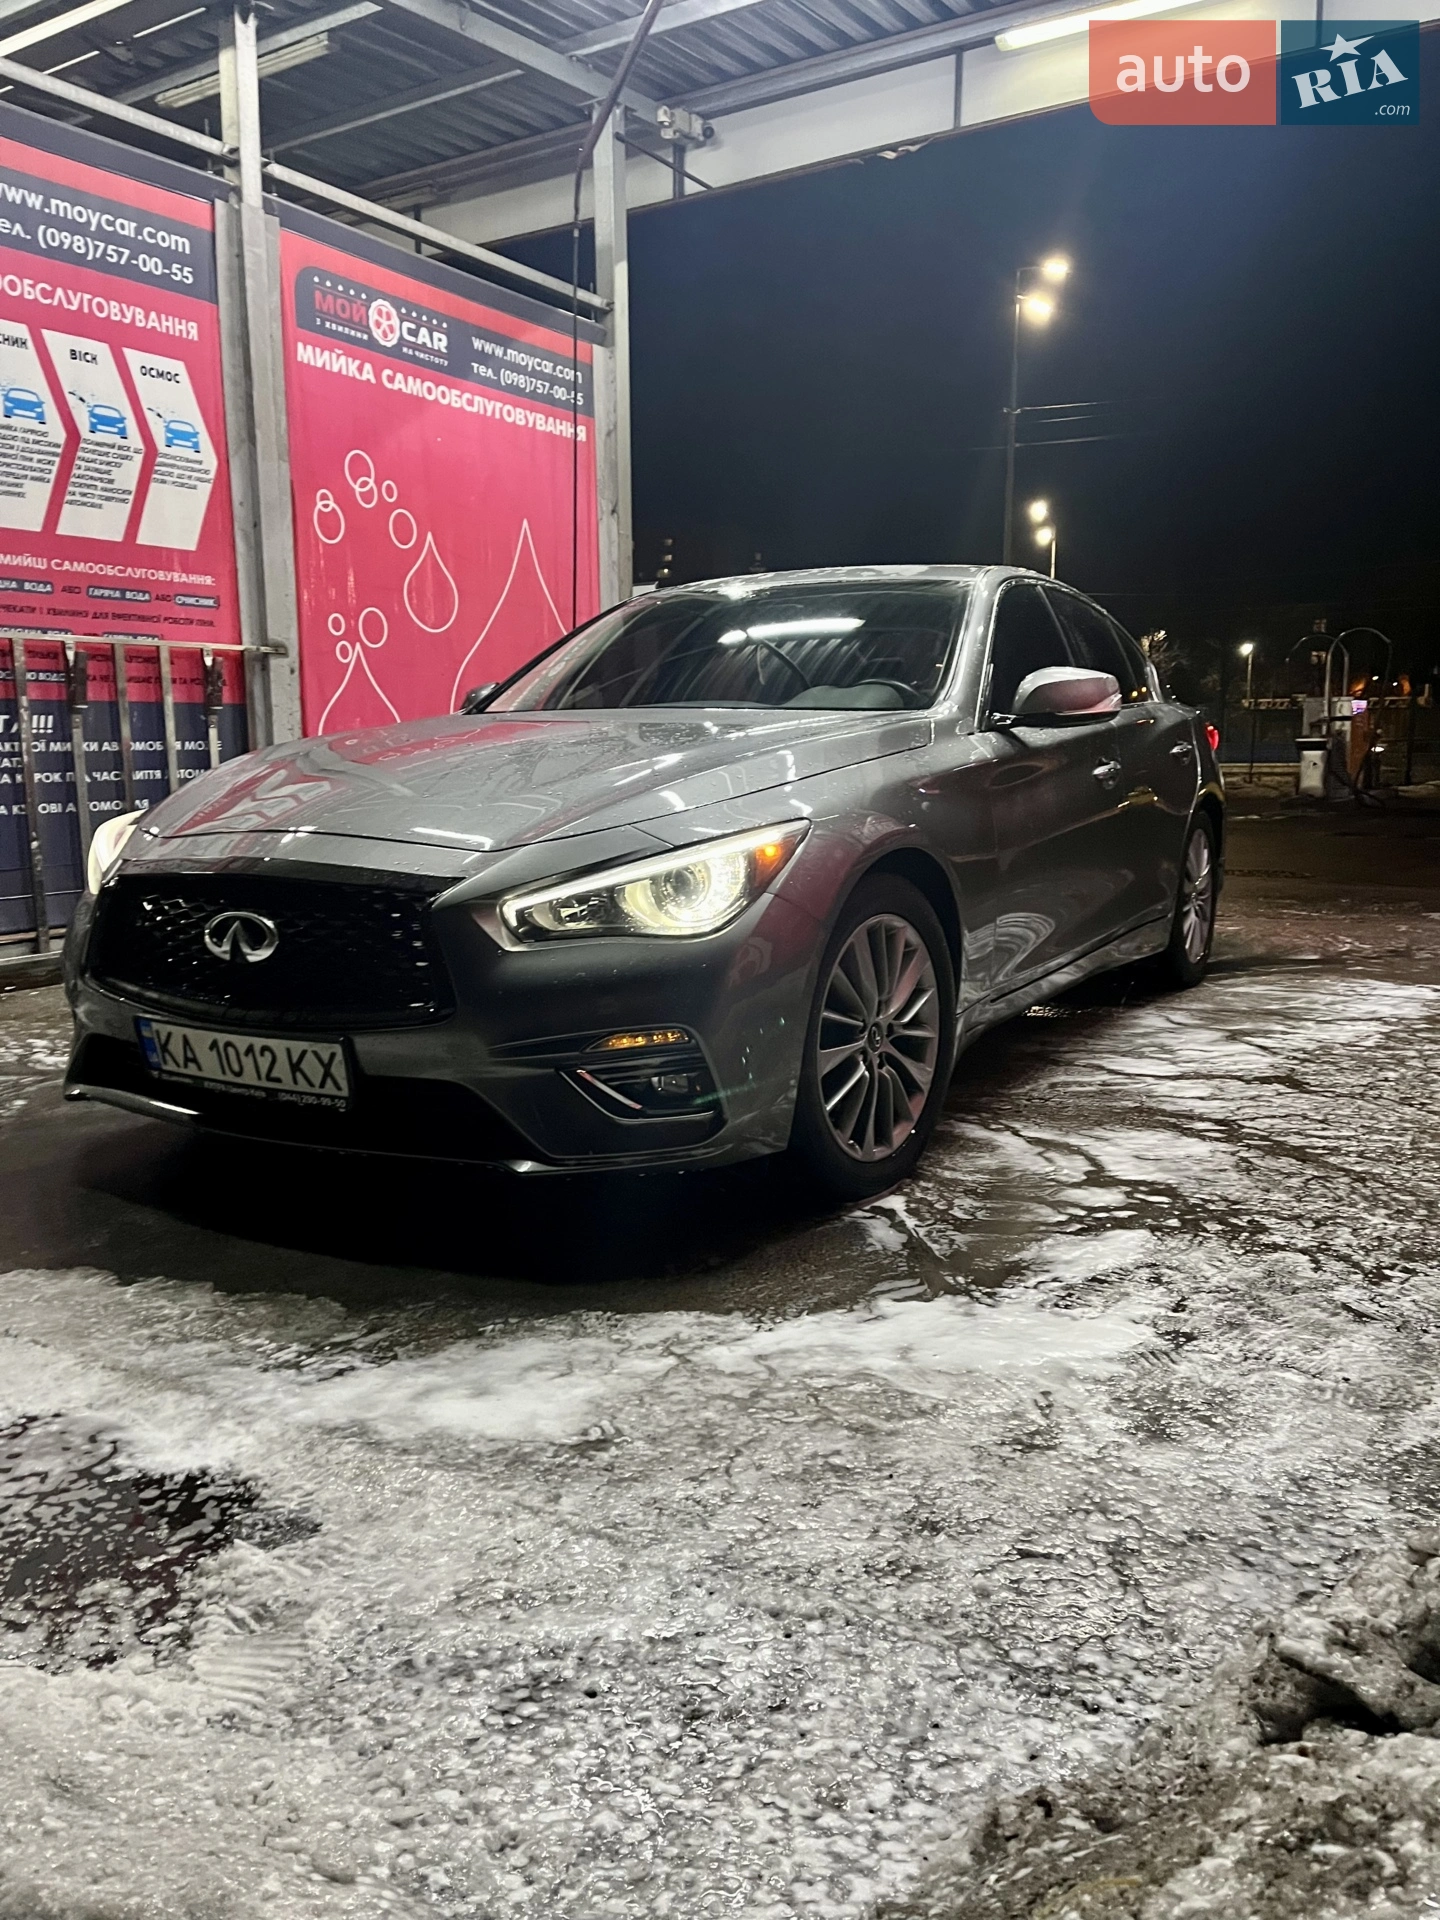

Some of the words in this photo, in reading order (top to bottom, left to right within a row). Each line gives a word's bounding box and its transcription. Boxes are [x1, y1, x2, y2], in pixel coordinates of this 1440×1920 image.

[0, 182, 191, 254] ww.moycar.com
[38, 225, 194, 284] (098)757-00-55
[0, 273, 199, 341] ОБСЛУГОВУВАННЯ
[314, 289, 368, 325] МОЙ
[401, 321, 448, 353] CAR
[140, 365, 181, 384] ОСМОС
[471, 336, 583, 384] www.moycar.com
[471, 362, 498, 379] тел.
[296, 342, 376, 385] МИЙКА
[382, 370, 587, 442] САМООБСЛУГОВУВАННЯ
[23, 581, 53, 592] ВОДА
[50, 558, 216, 586] САМООБСЛУГОВУВАННЯ:
[49, 741, 99, 752] МИКИ
[184, 740, 223, 751] МОЕ
[15, 772, 63, 783] КРОК
[92, 771, 121, 782] ЧАС
[155, 1029, 203, 1072] KA
[208, 1038, 283, 1084] 1012
[285, 1047, 343, 1092] KX
